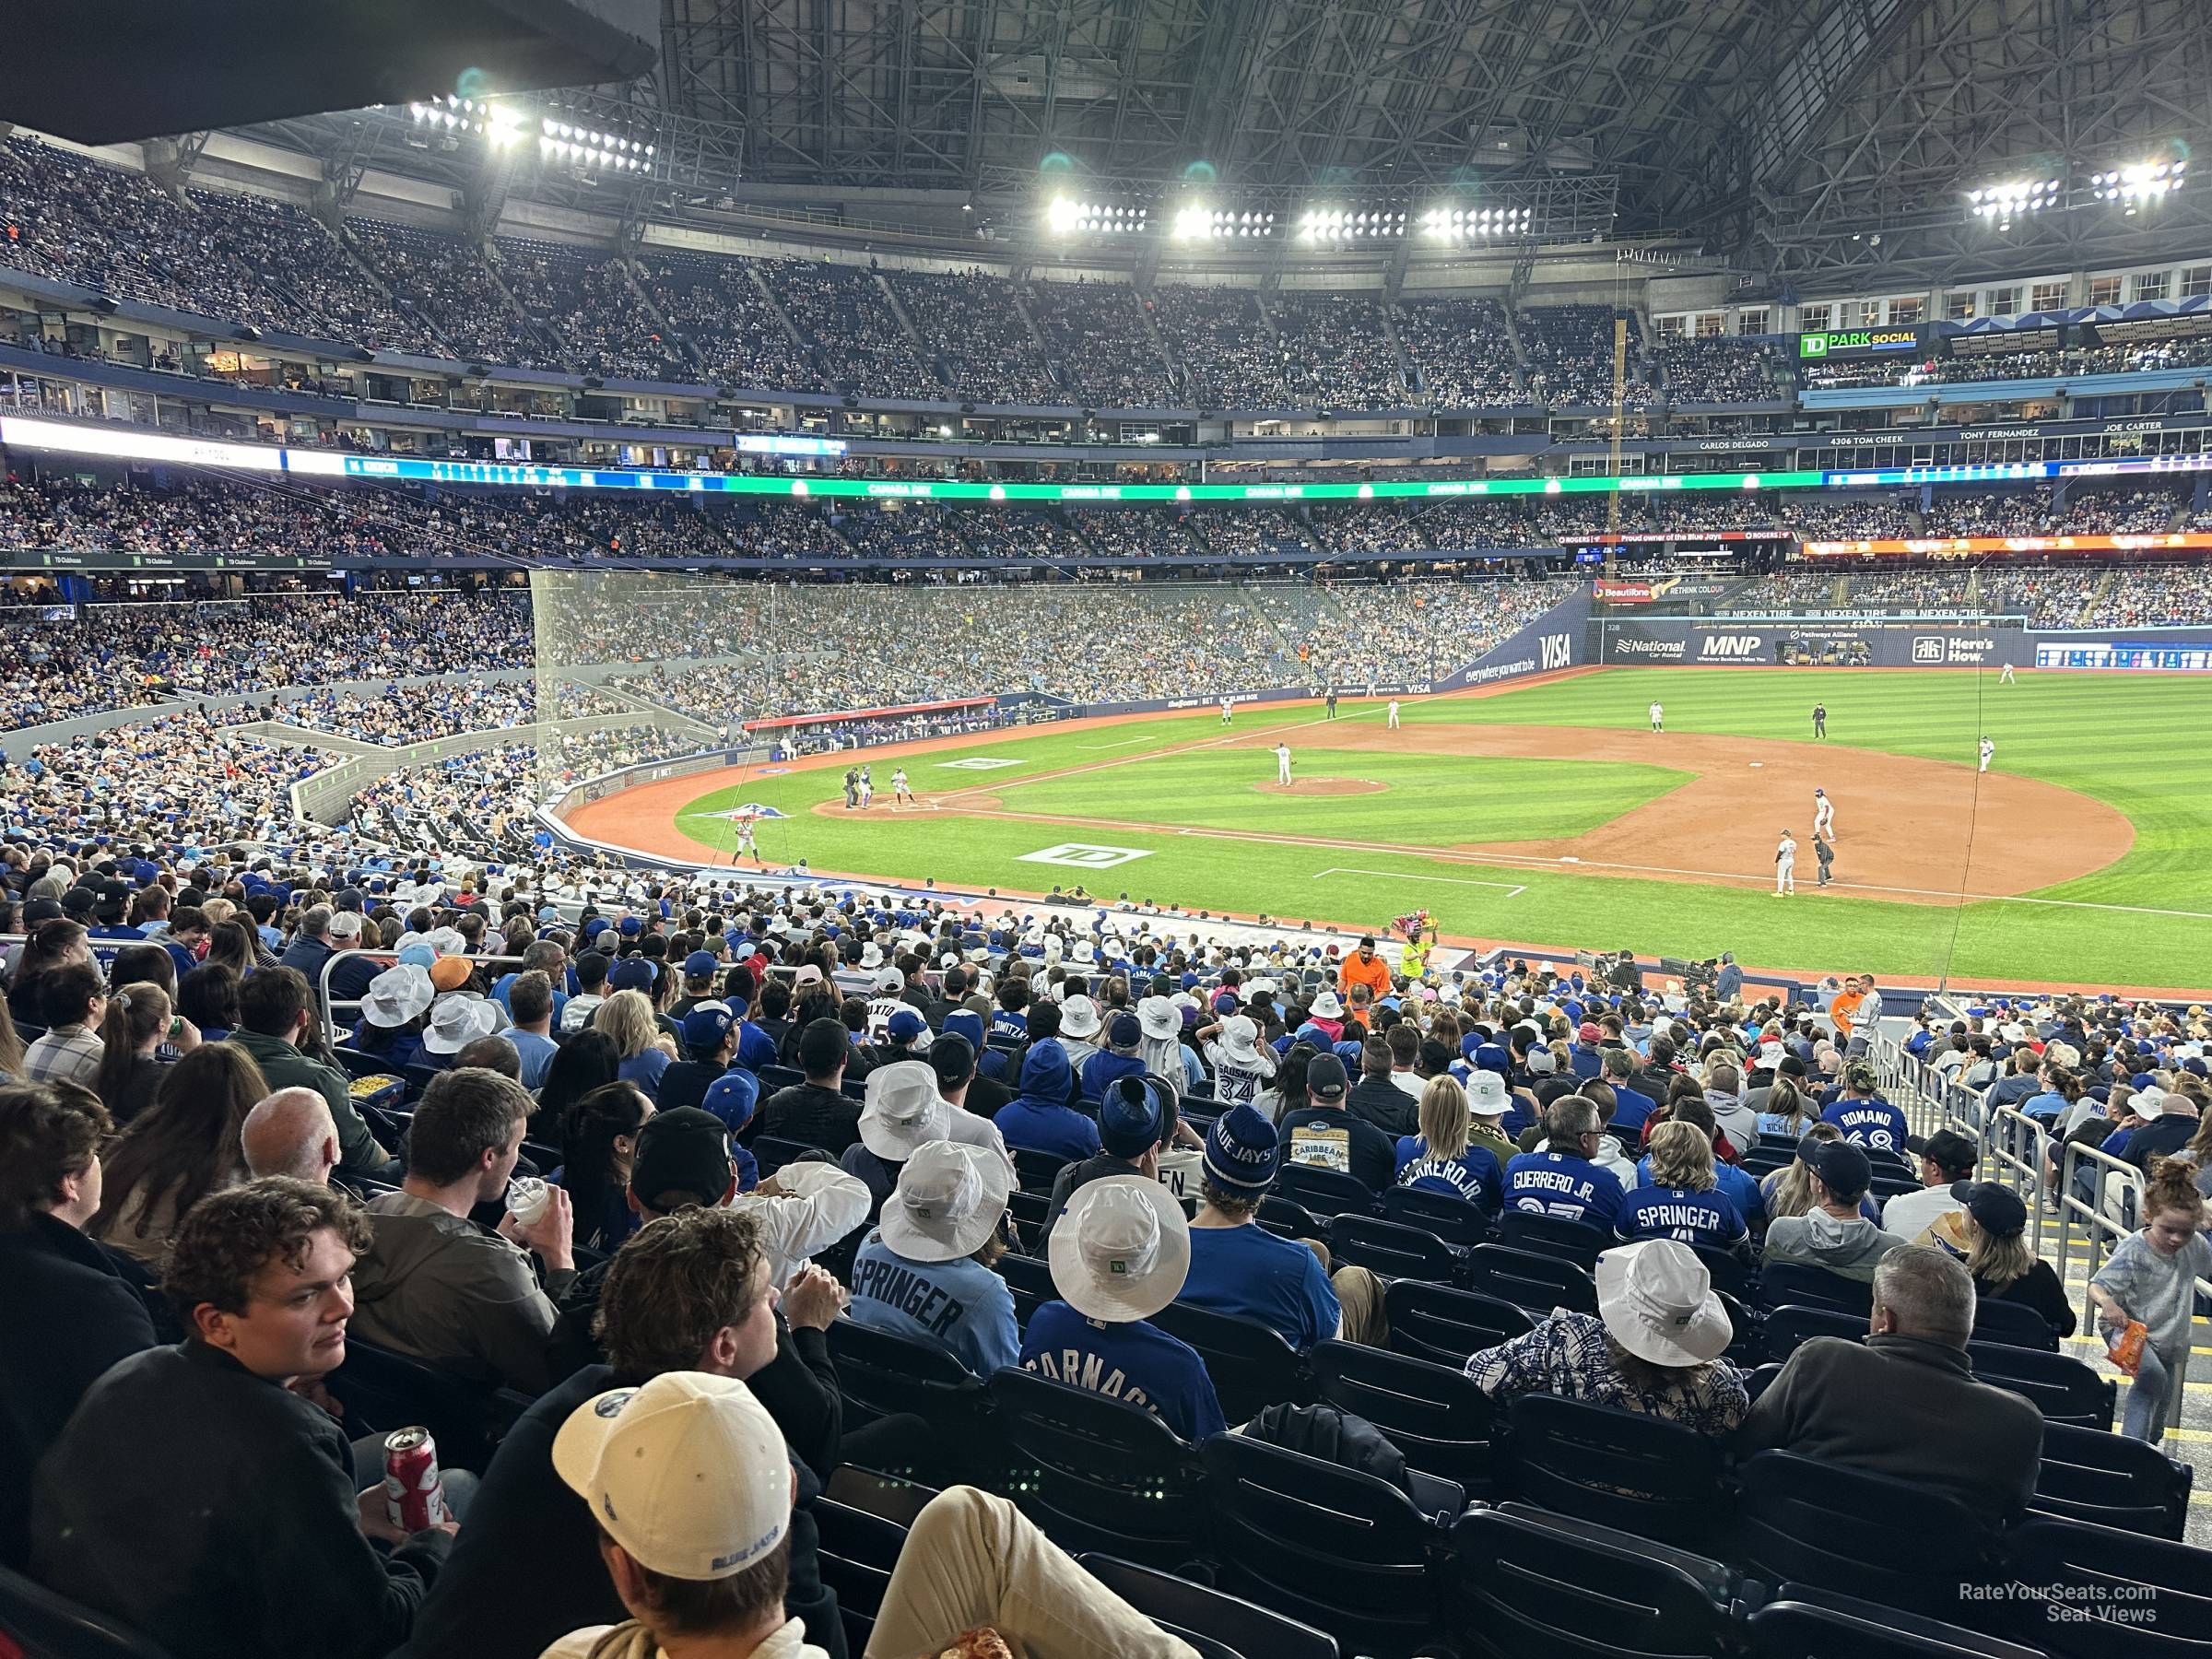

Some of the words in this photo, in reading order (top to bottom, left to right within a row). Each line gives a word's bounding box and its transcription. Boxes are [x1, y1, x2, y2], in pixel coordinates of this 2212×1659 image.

[1804, 337, 1824, 353] TD
[1829, 333, 1871, 346] PARK
[1872, 333, 1917, 344] SOCIAL
[2104, 423, 2123, 432] JOE
[2125, 422, 2162, 431] CARTER
[1876, 436, 1903, 444] CHEEK
[1959, 431, 1983, 440] TONY
[1987, 429, 2040, 439] FERNANDEZ
[1700, 441, 1730, 450] CARLOS
[1732, 441, 1769, 449] DELGADO
[1705, 534, 1723, 542] Jays
[1670, 585, 1699, 594] RETHINK
[1700, 584, 1724, 594] COLOUR
[1770, 610, 1794, 618] TIRE
[1863, 609, 1888, 618] TIRE
[1801, 630, 1830, 639] Pathways
[1701, 636, 1761, 655] MNP
[1947, 638, 1994, 650] Here's
[1539, 633, 1571, 670] VISA
[1947, 649, 1983, 662] How.
[1465, 665, 1499, 683] everywhere
[1509, 662, 1522, 673] want
[1406, 684, 1430, 693] VISA
[1051, 847, 1128, 862] TD
[867, 1004, 895, 1017] UXTO
[1219, 1076, 1255, 1103] 34
[2090, 1102, 2107, 1117] MO
[1841, 1111, 1891, 1127] ROMANO
[1217, 1122, 1235, 1153] BLUE
[1232, 1147, 1271, 1164] JAYS
[1295, 1146, 1344, 1158] CARIBBEAN
[1513, 1171, 1574, 1193] GUERRERO
[1637, 1206, 1720, 1230] SPRINGER
[852, 1258, 964, 1339] SPRINGER
